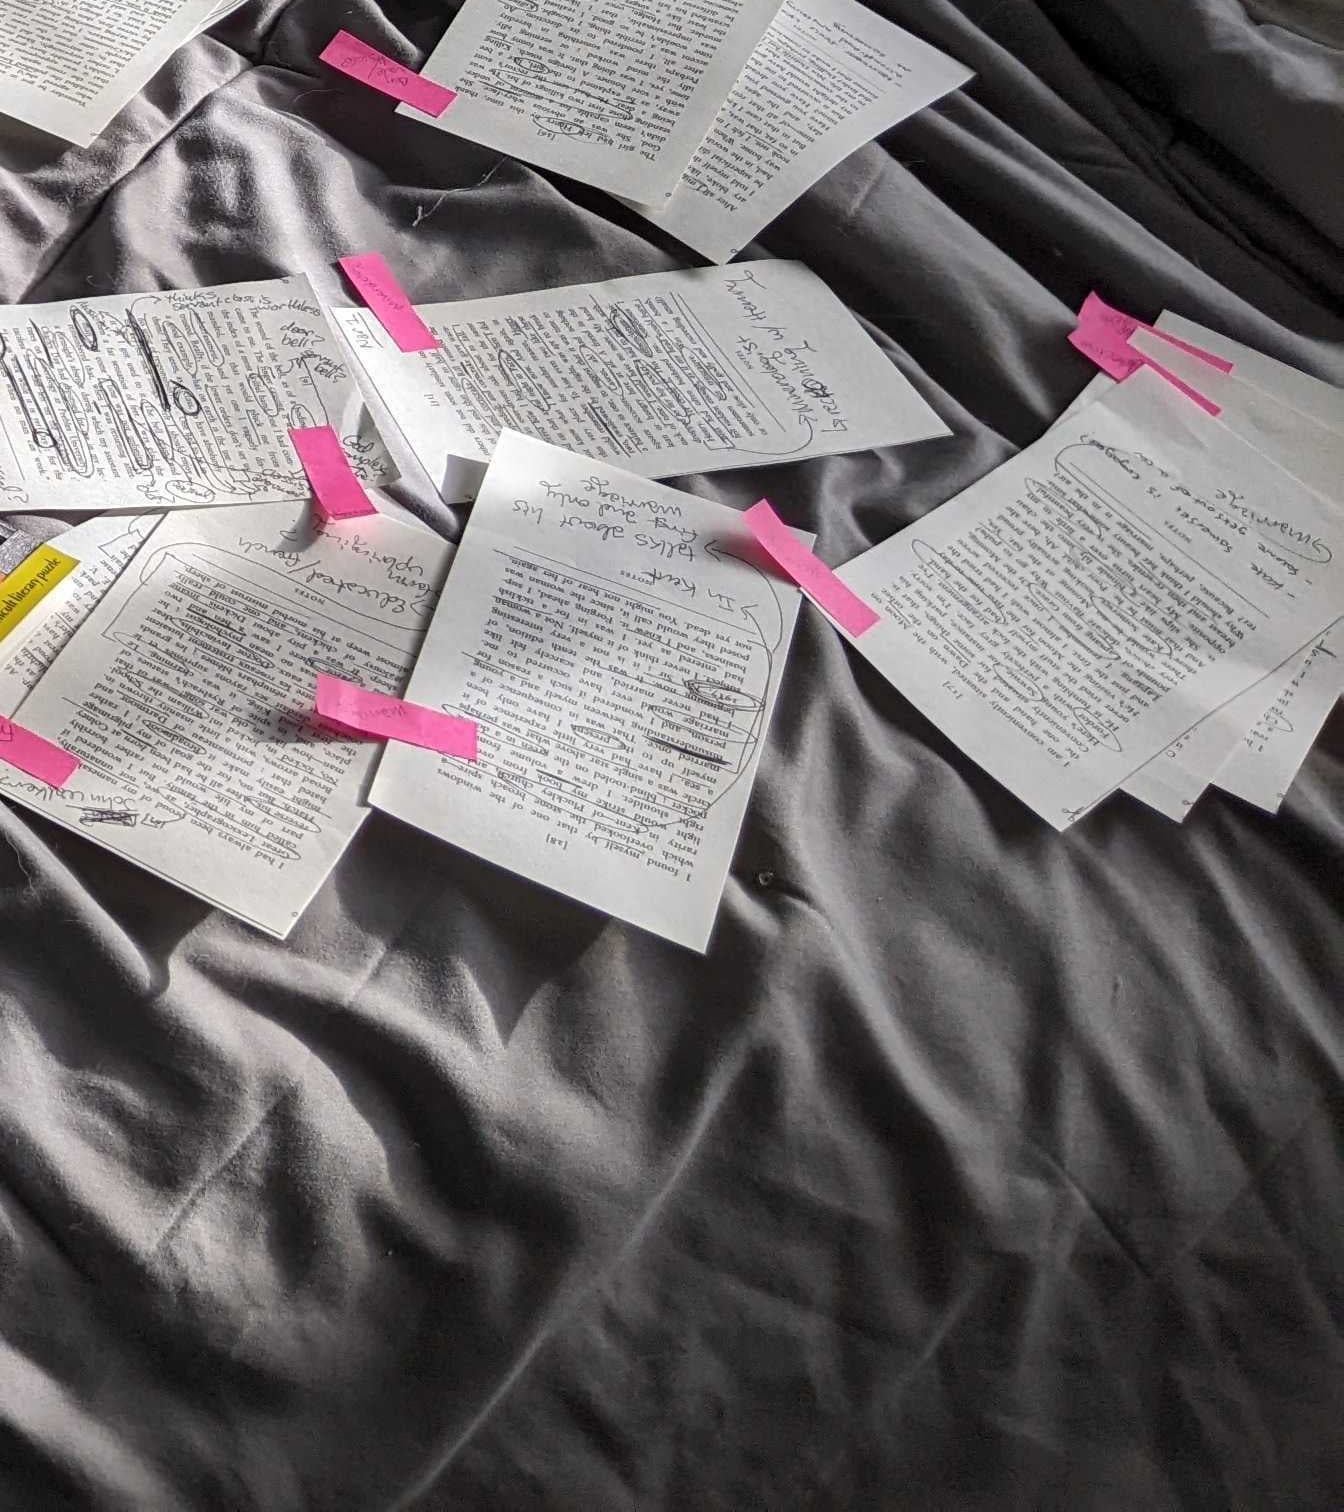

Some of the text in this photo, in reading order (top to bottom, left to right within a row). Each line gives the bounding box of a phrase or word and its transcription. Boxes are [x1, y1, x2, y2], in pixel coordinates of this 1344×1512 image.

[7, 578, 43, 602] literary
[36, 557, 61, 582] puzzle
[524, 657, 570, 678] occurred
[499, 683, 562, 712] consequence
[610, 676, 654, 697] married,
[114, 694, 171, 724] Dartmoor
[492, 705, 544, 729] experience
[592, 695, 643, 719] wondered
[436, 768, 482, 792] windows
[488, 791, 506, 803] the
[510, 801, 524, 810] of
[541, 787, 585, 812] Pluckley
[529, 809, 550, 821] one
[556, 820, 578, 834] that
[584, 831, 600, 845] by
[604, 835, 642, 859] myself
[646, 857, 679, 877] found
